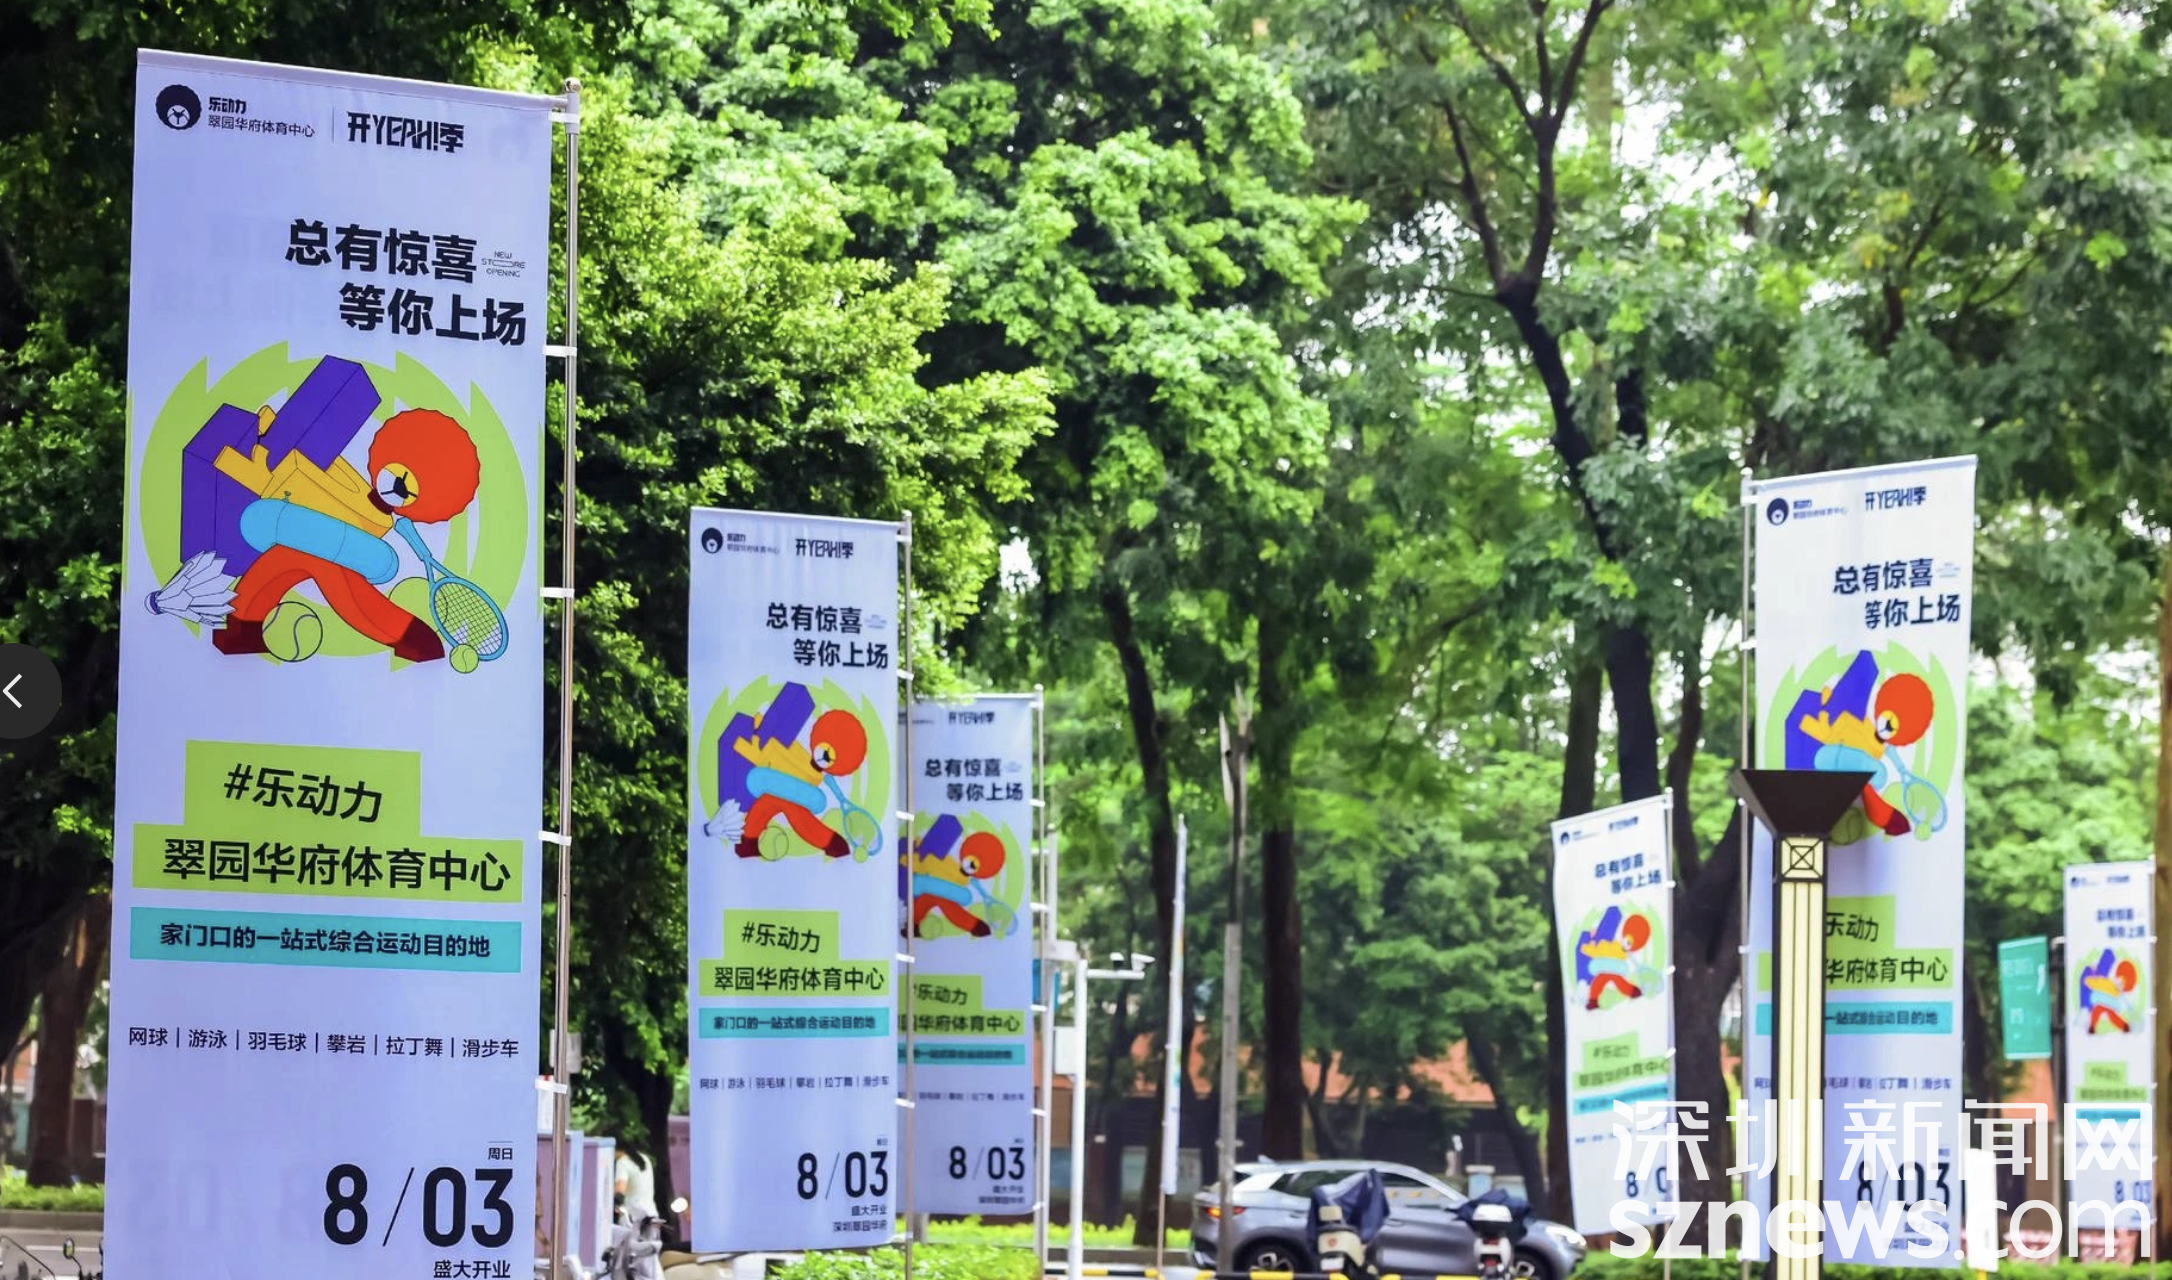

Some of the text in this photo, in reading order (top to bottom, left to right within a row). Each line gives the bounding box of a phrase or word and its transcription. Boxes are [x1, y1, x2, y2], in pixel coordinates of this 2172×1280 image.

[208, 96, 247, 114] 乐动力
[208, 115, 315, 138] 翠园华府体育中心
[347, 110, 465, 153] 开YEAH!季
[285, 218, 478, 284] 总有惊喜
[494, 250, 512, 259] NEW
[486, 268, 520, 278] OPENING
[339, 282, 526, 347] 等你上场
[1833, 558, 1934, 595] 总有惊喜
[766, 602, 863, 634] 总有惊喜
[1864, 594, 1961, 630] 等你上场
[793, 639, 888, 670] 等你上场
[925, 758, 1001, 778] 总有惊喜
[224, 763, 382, 822] #乐动力
[947, 782, 1023, 802] 等你上场
[163, 838, 511, 892] 翠园华府体育中心
[160, 922, 491, 958] 家门口的一站式综合运动目的地
[741, 921, 820, 953] #乐动力
[714, 966, 885, 992] 翠园华府体育中心
[713, 1015, 876, 1030] 家门口的一站式综合运动目的地
[898, 1014, 1020, 1032] 华府体育中心
[129, 1027, 519, 1058] 网球 游泳 羽毛球 攀岩 拉丁舞 滑步车
[488, 1146, 513, 1161] 周日
[949, 1146, 1025, 1180] 8/03
[797, 1151, 888, 1200] 8/03
[323, 1163, 514, 1248] 8/03
[433, 1260, 511, 1279] 盛大开业
